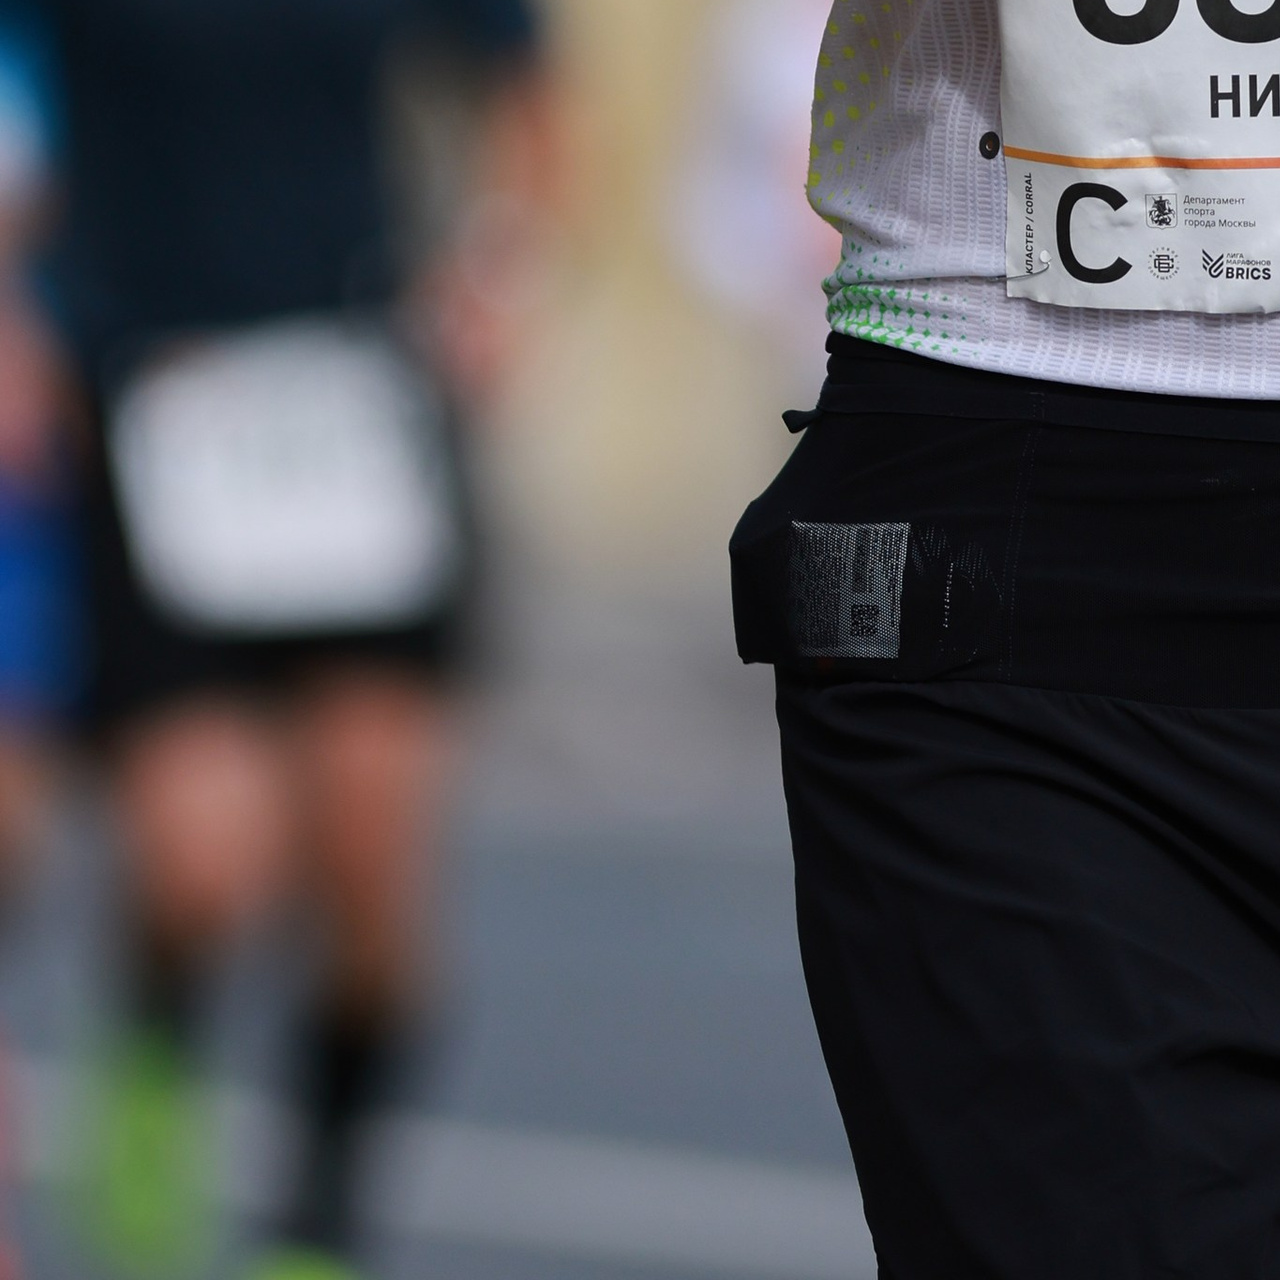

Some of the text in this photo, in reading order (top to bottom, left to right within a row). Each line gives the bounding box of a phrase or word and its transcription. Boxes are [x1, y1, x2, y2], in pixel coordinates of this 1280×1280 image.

[1024, 172, 1033, 215] CORRAL
[1183, 195, 1245, 206] Департамент
[1184, 207, 1216, 217] спорта
[1184, 218, 1256, 229] города Москвы
[1056, 182, 1133, 284] C
[1025, 223, 1034, 274] КЛАСТЕР
[1226, 267, 1272, 280] BRICS
